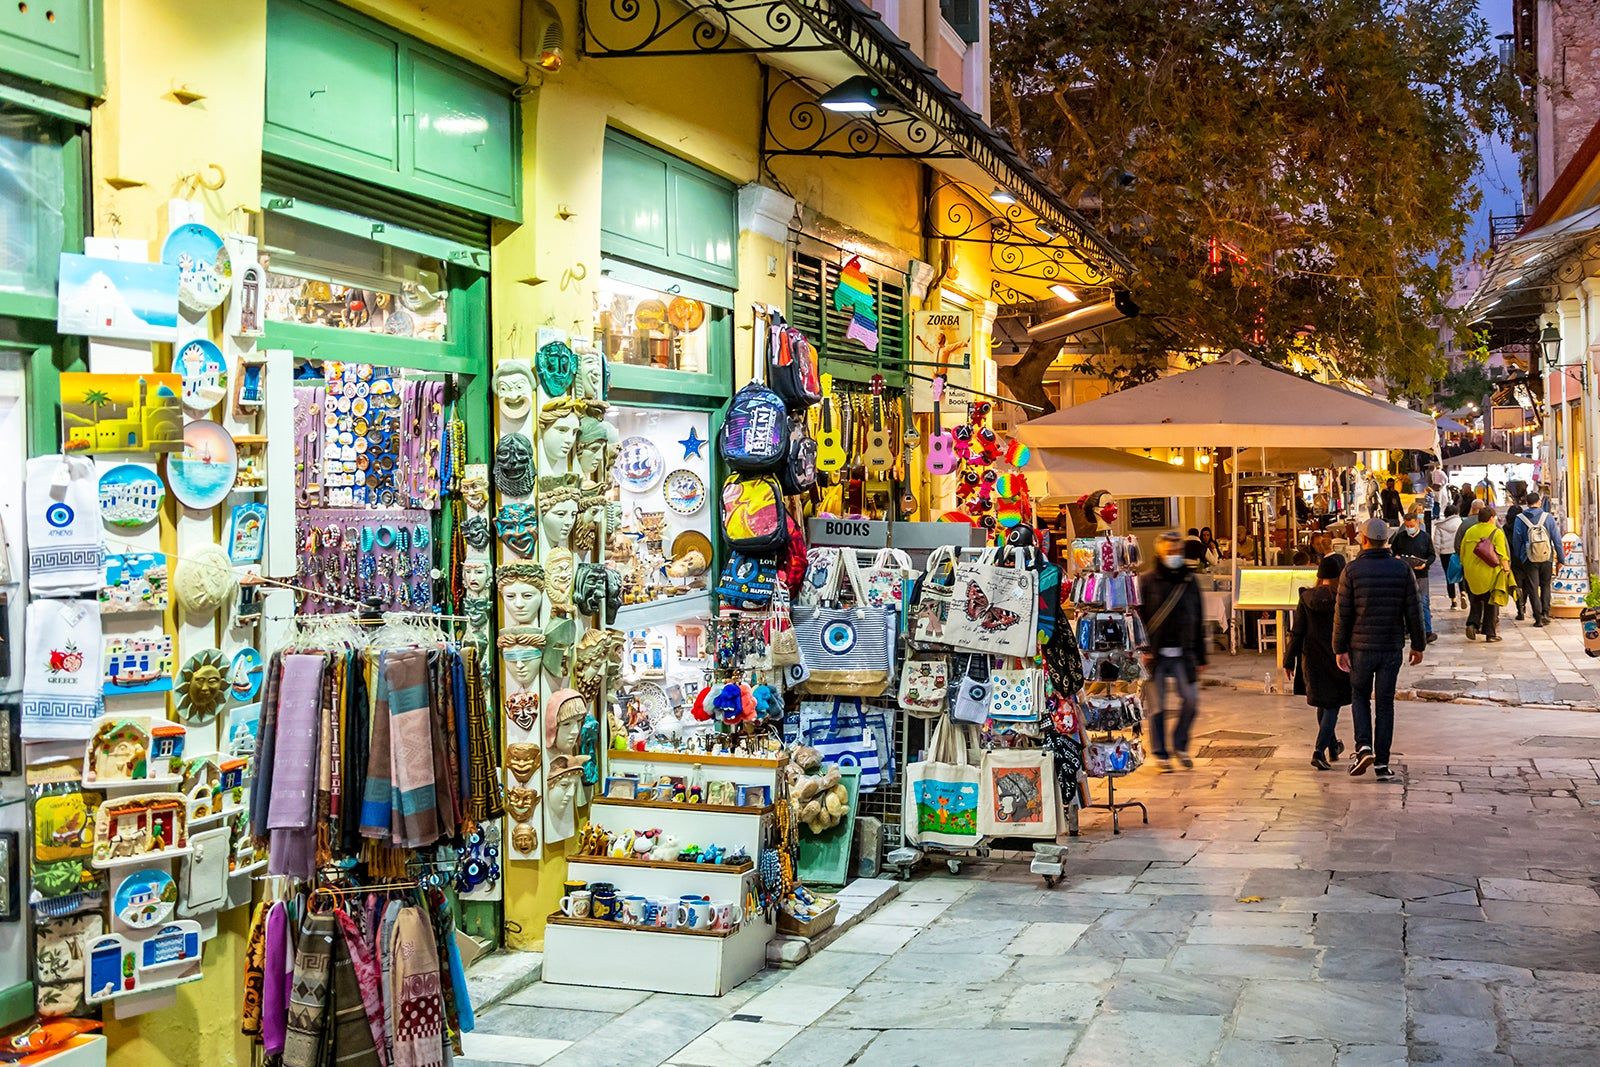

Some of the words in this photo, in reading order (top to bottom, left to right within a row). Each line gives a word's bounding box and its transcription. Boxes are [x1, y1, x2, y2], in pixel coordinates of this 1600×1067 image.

[927, 315, 960, 326] ZORBA
[752, 412, 770, 451] BKLN
[48, 529, 73, 537] ATHENS
[825, 521, 870, 537] BOOKS
[47, 677, 78, 685] GREECE
